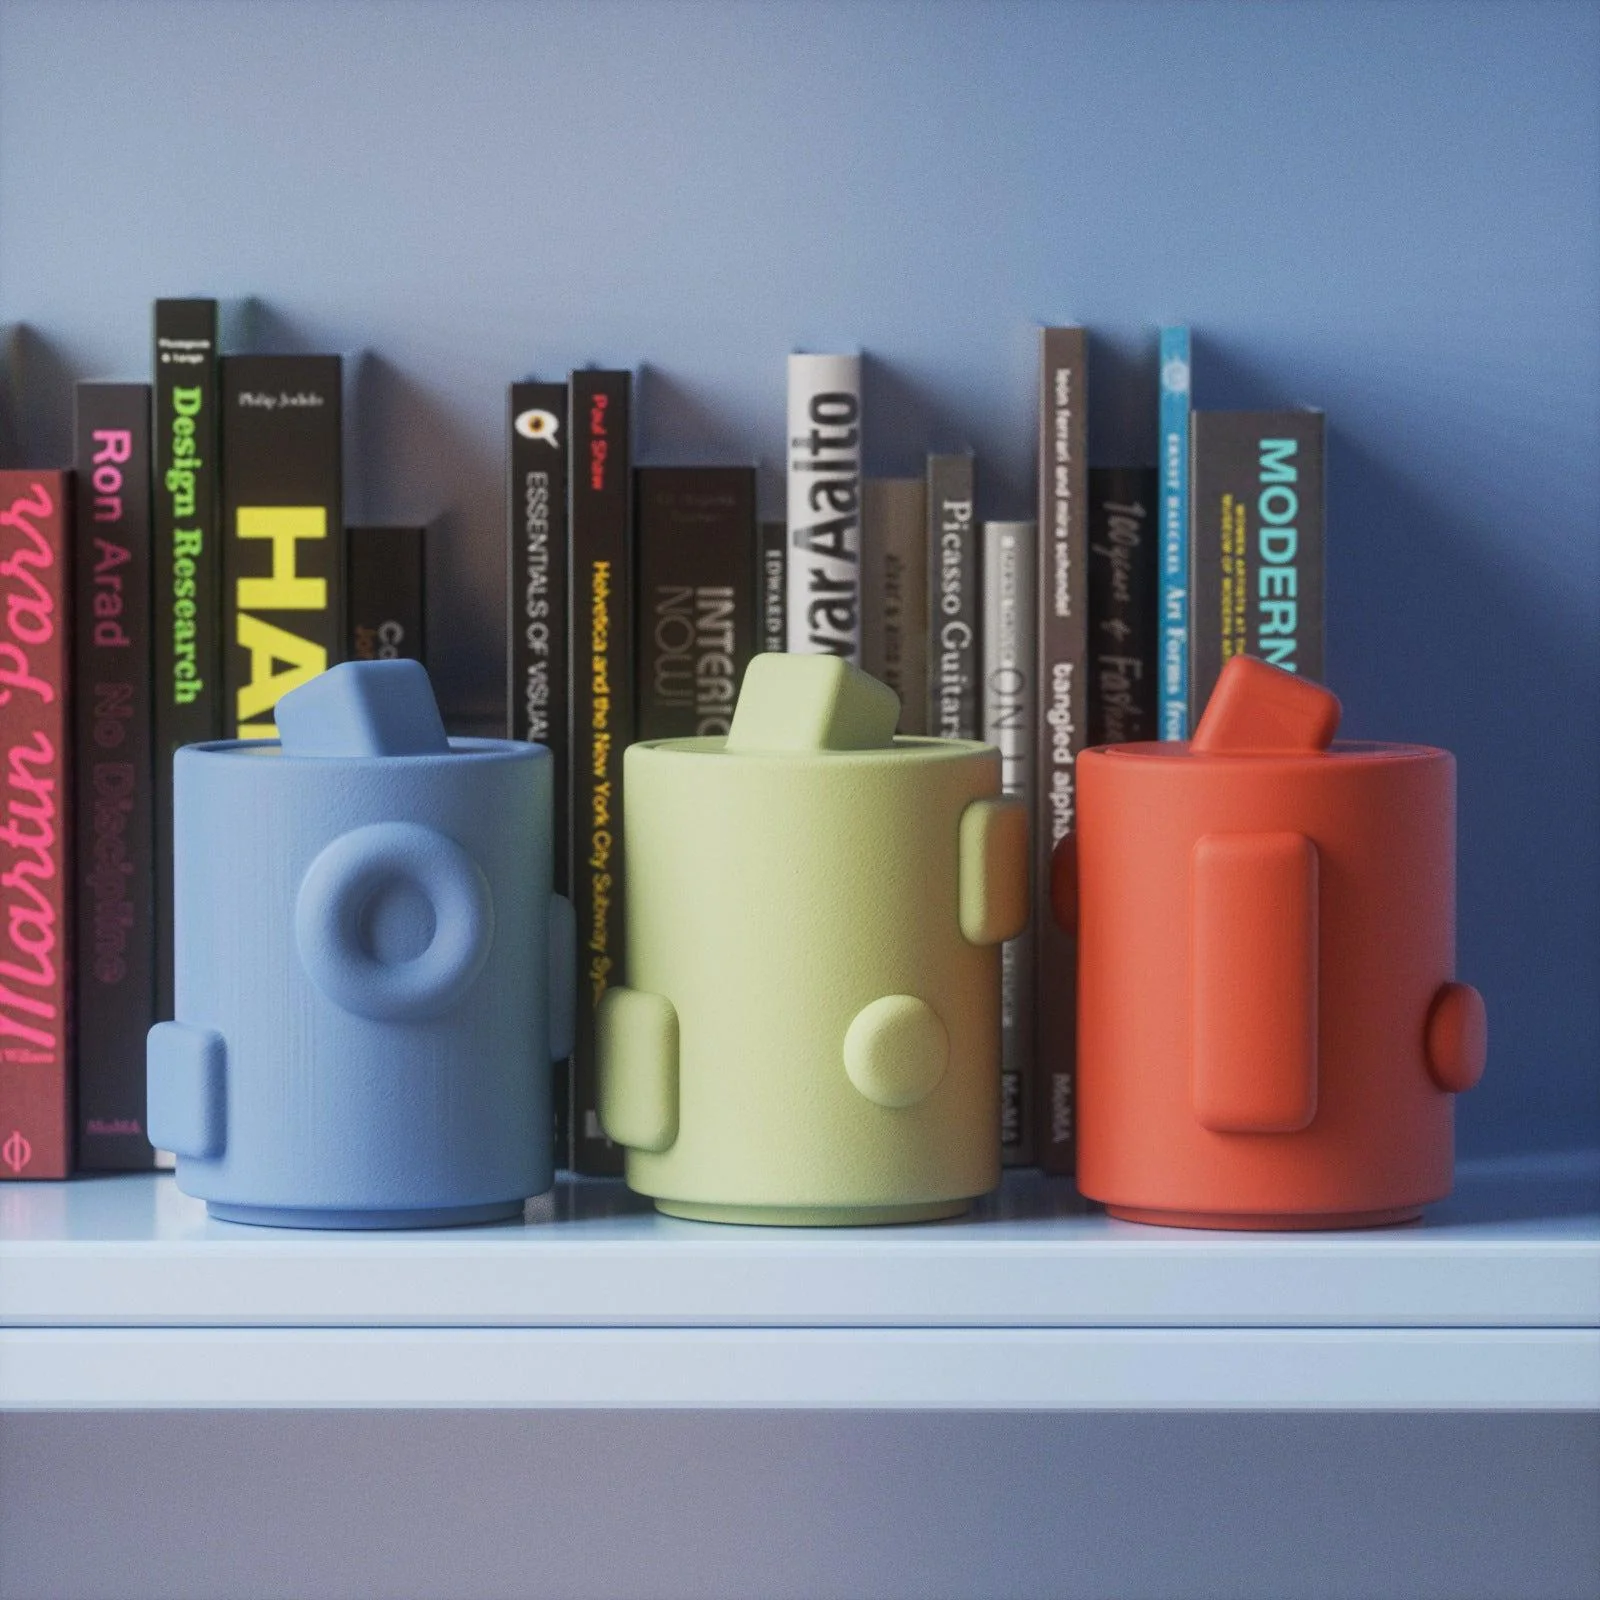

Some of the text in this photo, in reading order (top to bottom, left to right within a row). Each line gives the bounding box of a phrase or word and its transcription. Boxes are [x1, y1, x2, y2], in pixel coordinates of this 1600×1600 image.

[92, 429, 132, 522] Ron
[166, 385, 204, 704] Design Research
[526, 470, 549, 618] ESSENTIALS
[941, 498, 973, 614] Picasso
[1258, 438, 1298, 672] MODERN
[93, 537, 131, 648] Arad
[526, 621, 549, 655] OF
[592, 560, 610, 652] Helvetica
[592, 655, 610, 694] and
[696, 585, 735, 737] INTERIO
[592, 696, 609, 729] the
[592, 732, 611, 777] New
[0, 484, 54, 1065] Martin Parr
[593, 781, 612, 825] York
[589, 829, 612, 868] City
